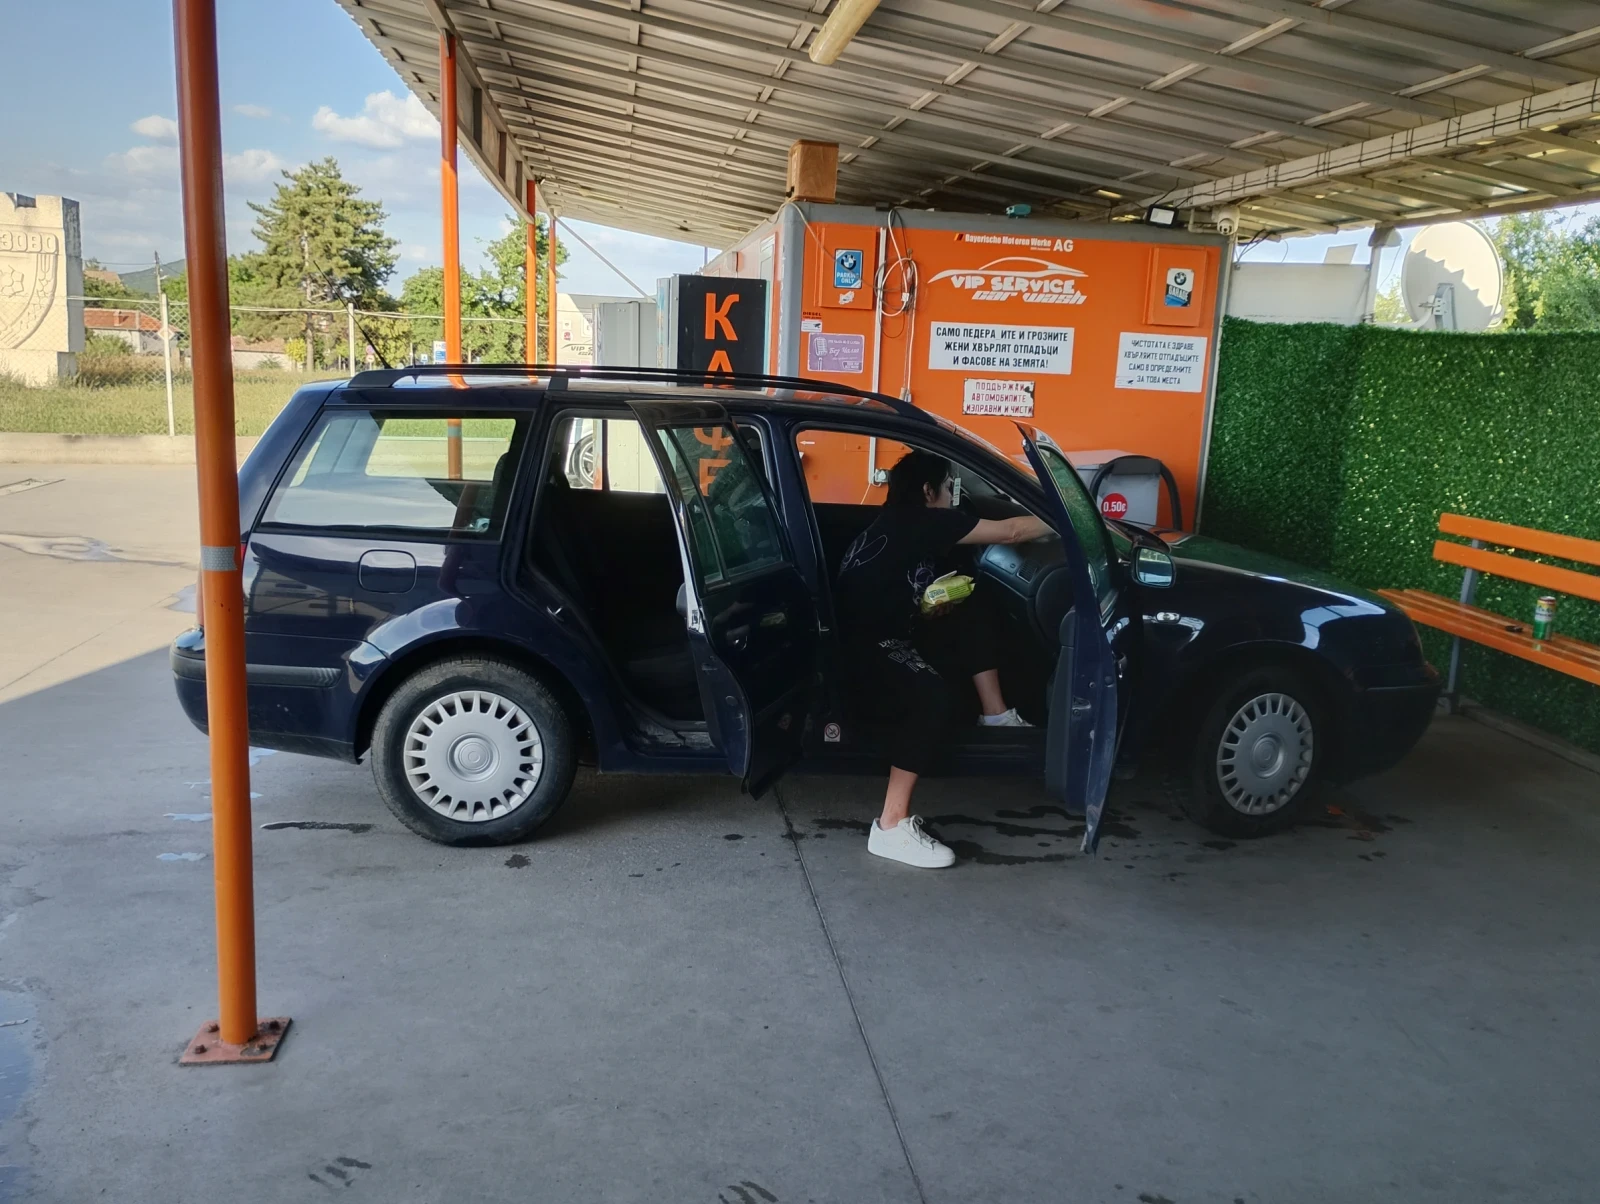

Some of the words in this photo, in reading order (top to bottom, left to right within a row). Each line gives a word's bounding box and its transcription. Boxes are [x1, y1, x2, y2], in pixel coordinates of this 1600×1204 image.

[965, 233, 1001, 244] Bayerische
[1030, 237, 1052, 247] Werke
[1053, 239, 1074, 252] AG
[950, 275, 985, 289] VIP
[990, 277, 1075, 294] SERVICE
[972, 290, 1018, 301] car
[1022, 289, 1087, 305] wash
[936, 327, 960, 338] САМО
[1019, 330, 1025, 340] И
[1027, 331, 1068, 342] ГРОЗНИТЕ
[944, 341, 970, 351] ЖЕНИ
[972, 343, 1012, 353] ХВЪРЛЯТ
[1013, 343, 1059, 355] ОТПАДЪЦИ
[1131, 339, 1166, 349] ЧИСТОТАТА
[1172, 342, 1194, 351] ЗДРАВЕ
[953, 355, 959, 365] И
[961, 356, 996, 367] ФАСОВЕ
[999, 357, 1010, 367] НА
[1012, 358, 1049, 369] ЗЕМЯТА!
[1128, 362, 1145, 372] САМО
[1137, 375, 1145, 383] ЗА
[1146, 376, 1160, 384] ТОВА
[1162, 377, 1181, 385] МЕСТА
[966, 404, 1002, 413] ИЗПРАВНИ
[1004, 405, 1009, 413] И
[1010, 406, 1033, 415] ЧИСТИ
